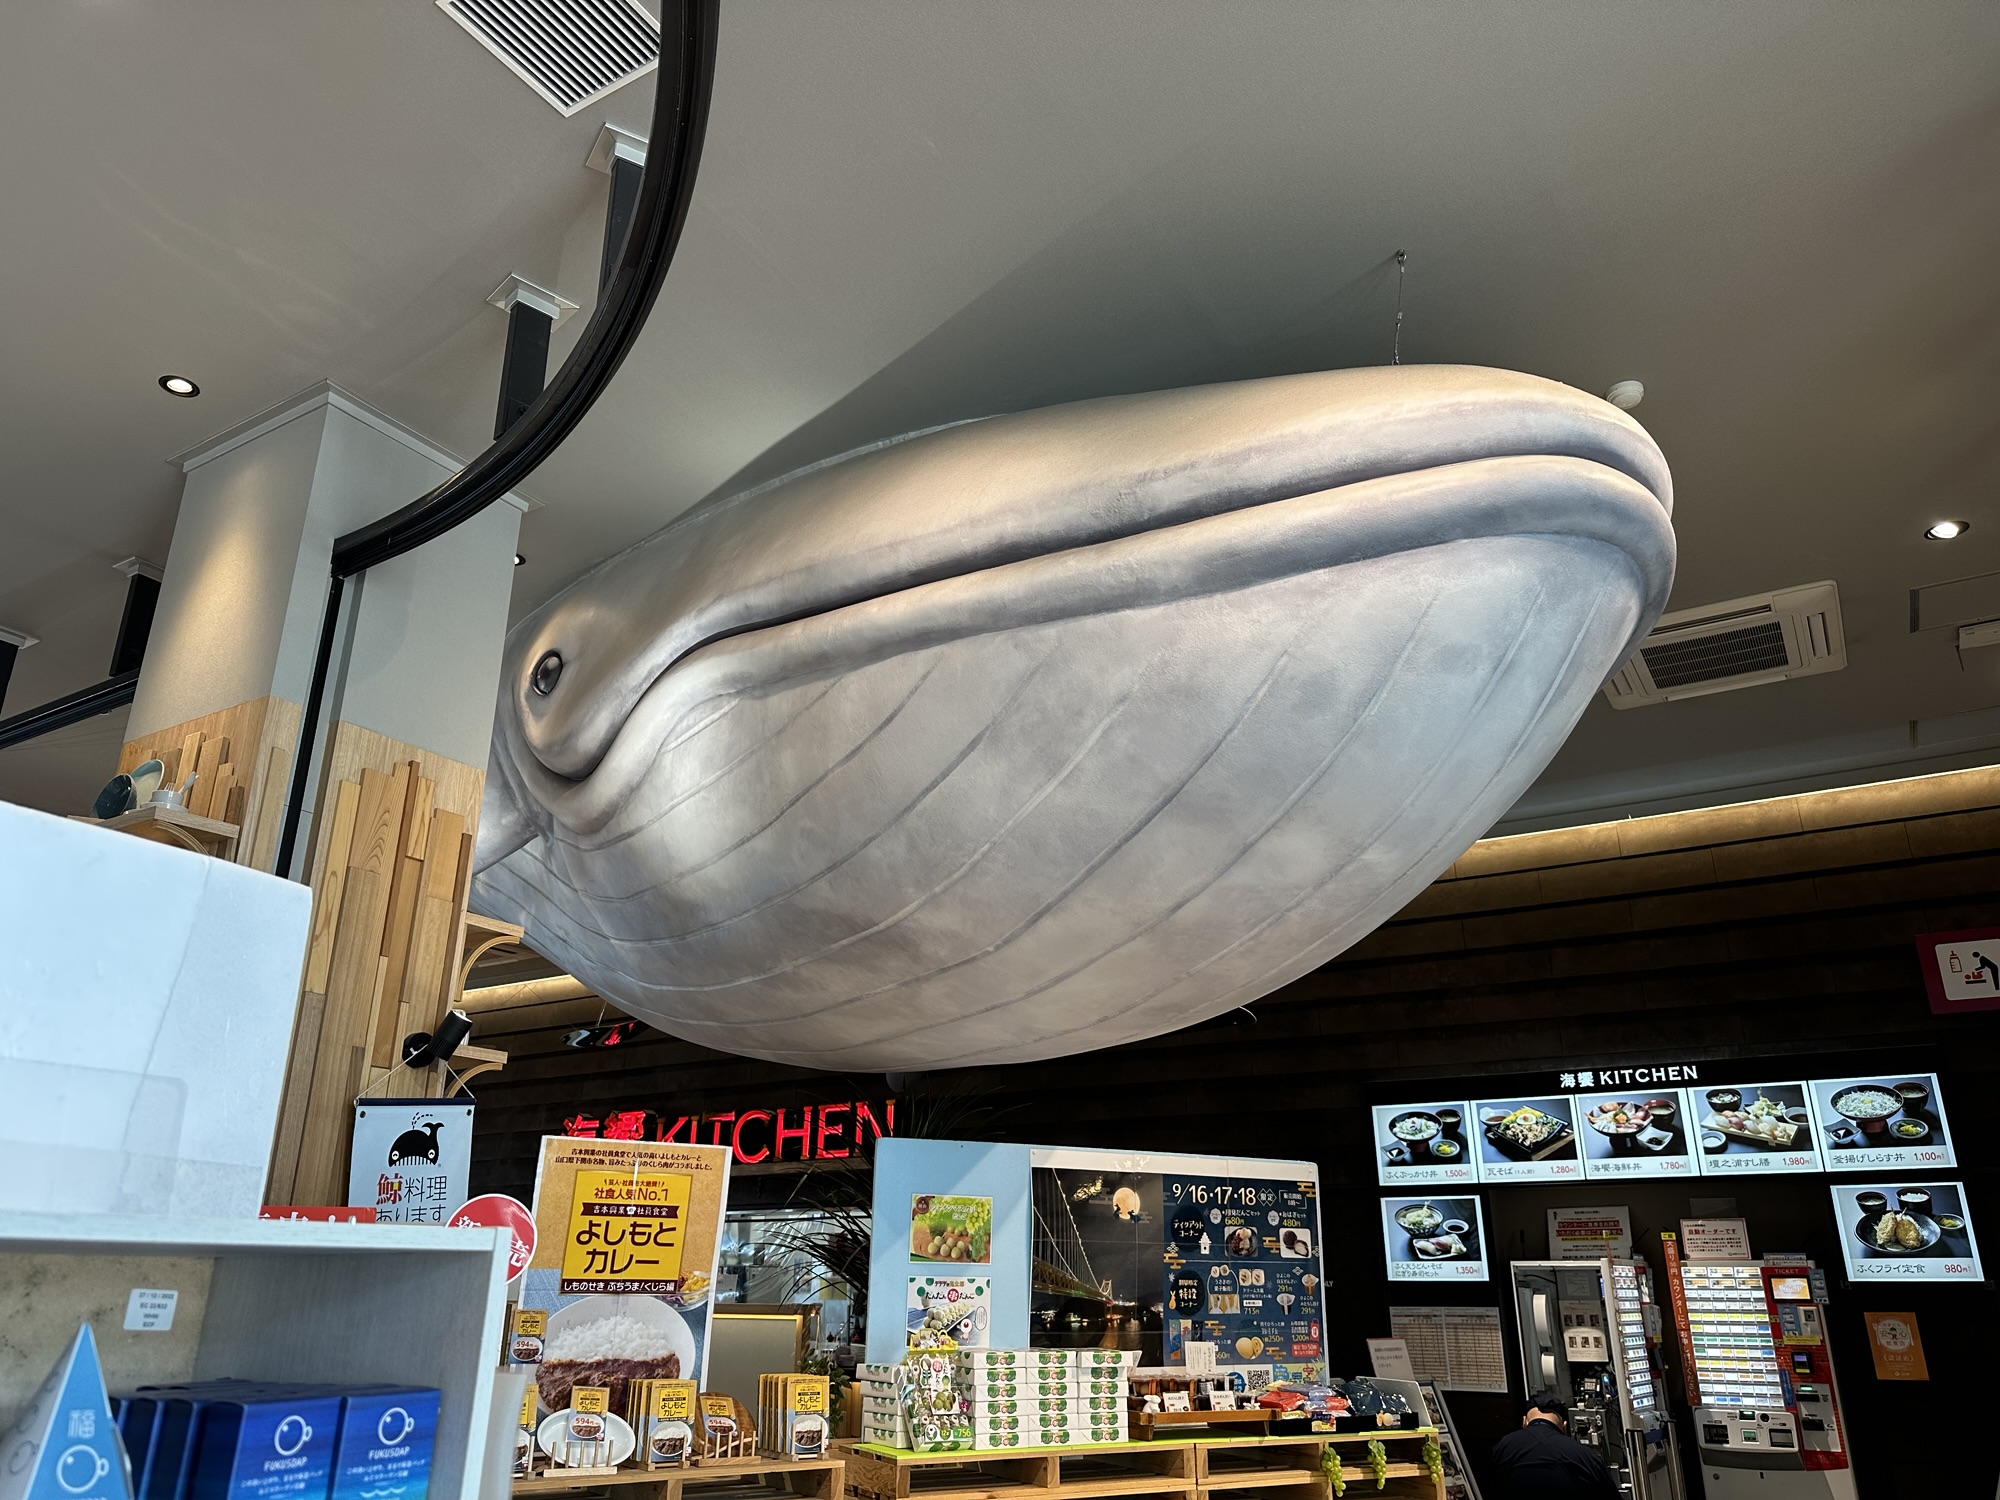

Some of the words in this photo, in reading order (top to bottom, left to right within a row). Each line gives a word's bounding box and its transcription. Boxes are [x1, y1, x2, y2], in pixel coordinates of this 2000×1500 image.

[1600, 1065, 1698, 1085] KITCHEN
[1833, 1153, 1906, 1164] 釜揚げしらす丼
[376, 1173, 448, 1205] 鯨料理
[636, 1206, 669, 1216] 社員食堂
[576, 1220, 677, 1247] よしもと
[583, 1248, 660, 1274] カレー
[1857, 1264, 1926, 1274] ふくフライ定食
[564, 1282, 605, 1291] しものせき
[797, 1396, 821, 1404] よしもと
[660, 1402, 687, 1410] よしもと
[663, 1409, 683, 1417] カレー
[368, 1446, 410, 1460] FUKUSOAP
[263, 1456, 308, 1472] FUKUSOAP
